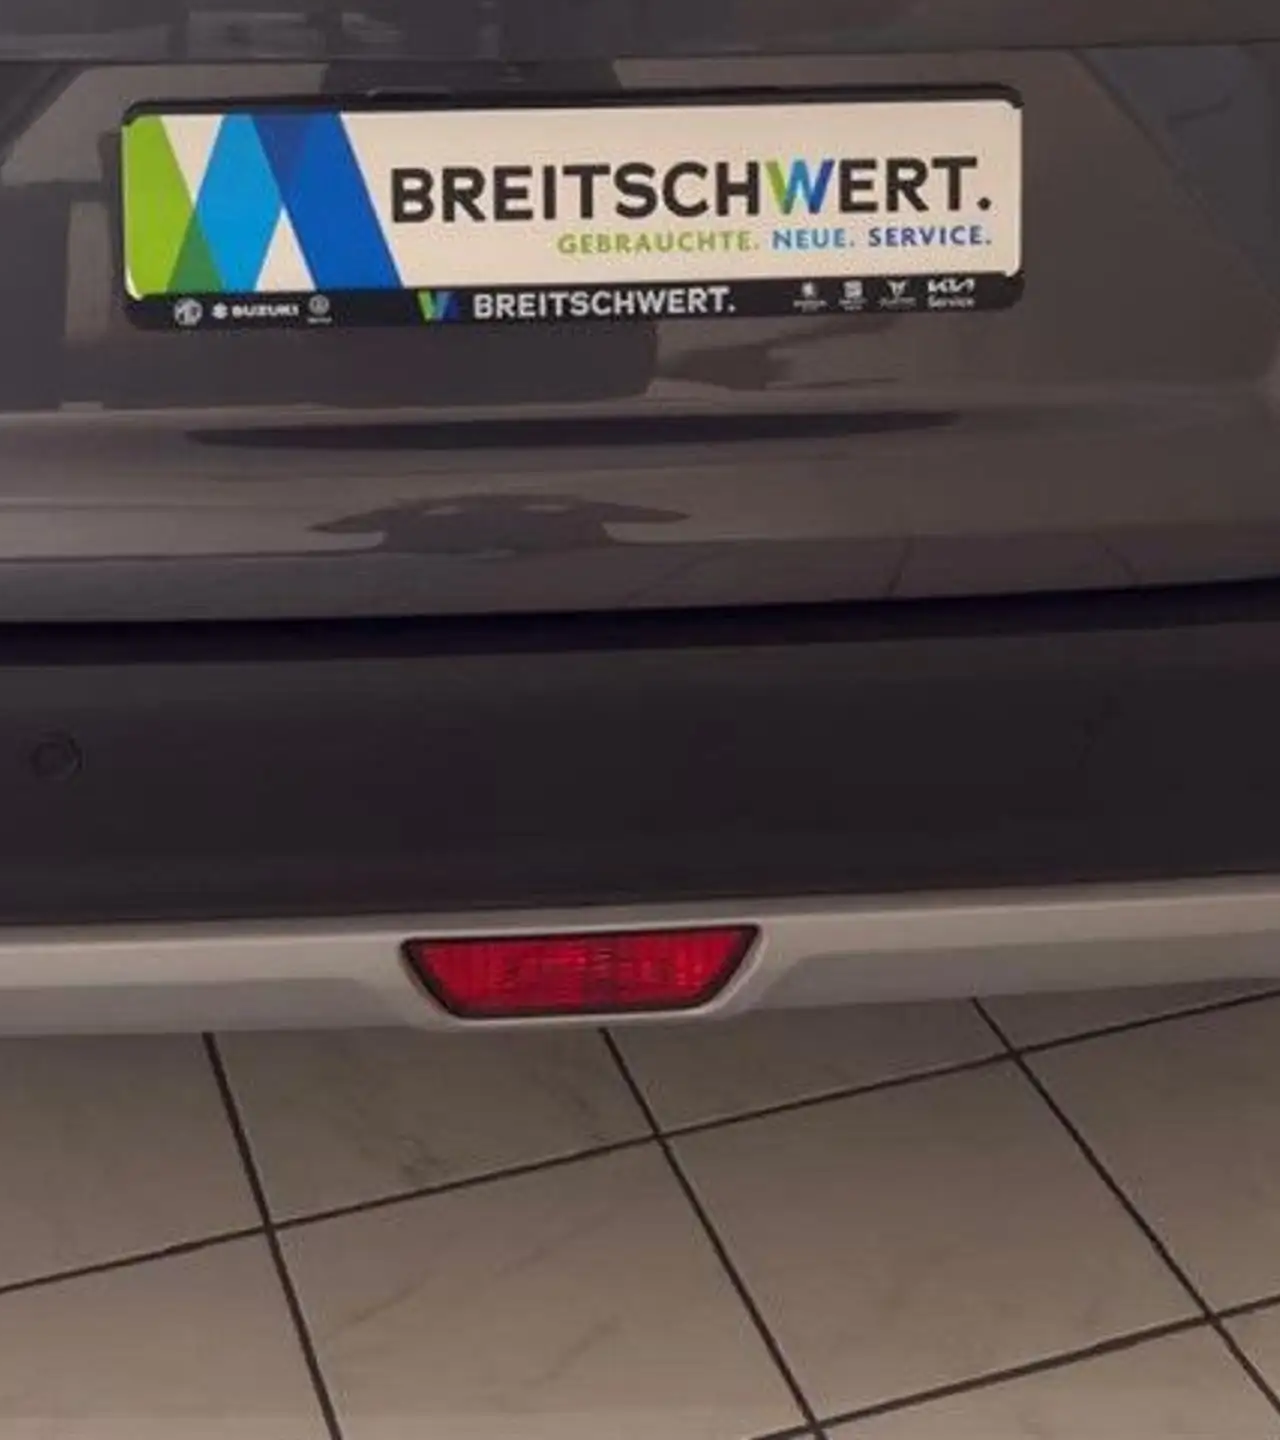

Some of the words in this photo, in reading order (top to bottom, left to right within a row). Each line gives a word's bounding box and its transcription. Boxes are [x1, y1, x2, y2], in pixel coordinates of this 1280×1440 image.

[390, 156, 993, 223] BREITSCHWERT.
[556, 229, 760, 255] GEBRAUCHTE.
[772, 227, 856, 250] NEUE.
[867, 224, 992, 247] SERVICE.
[472, 286, 737, 320] BREITSCHWERT.
